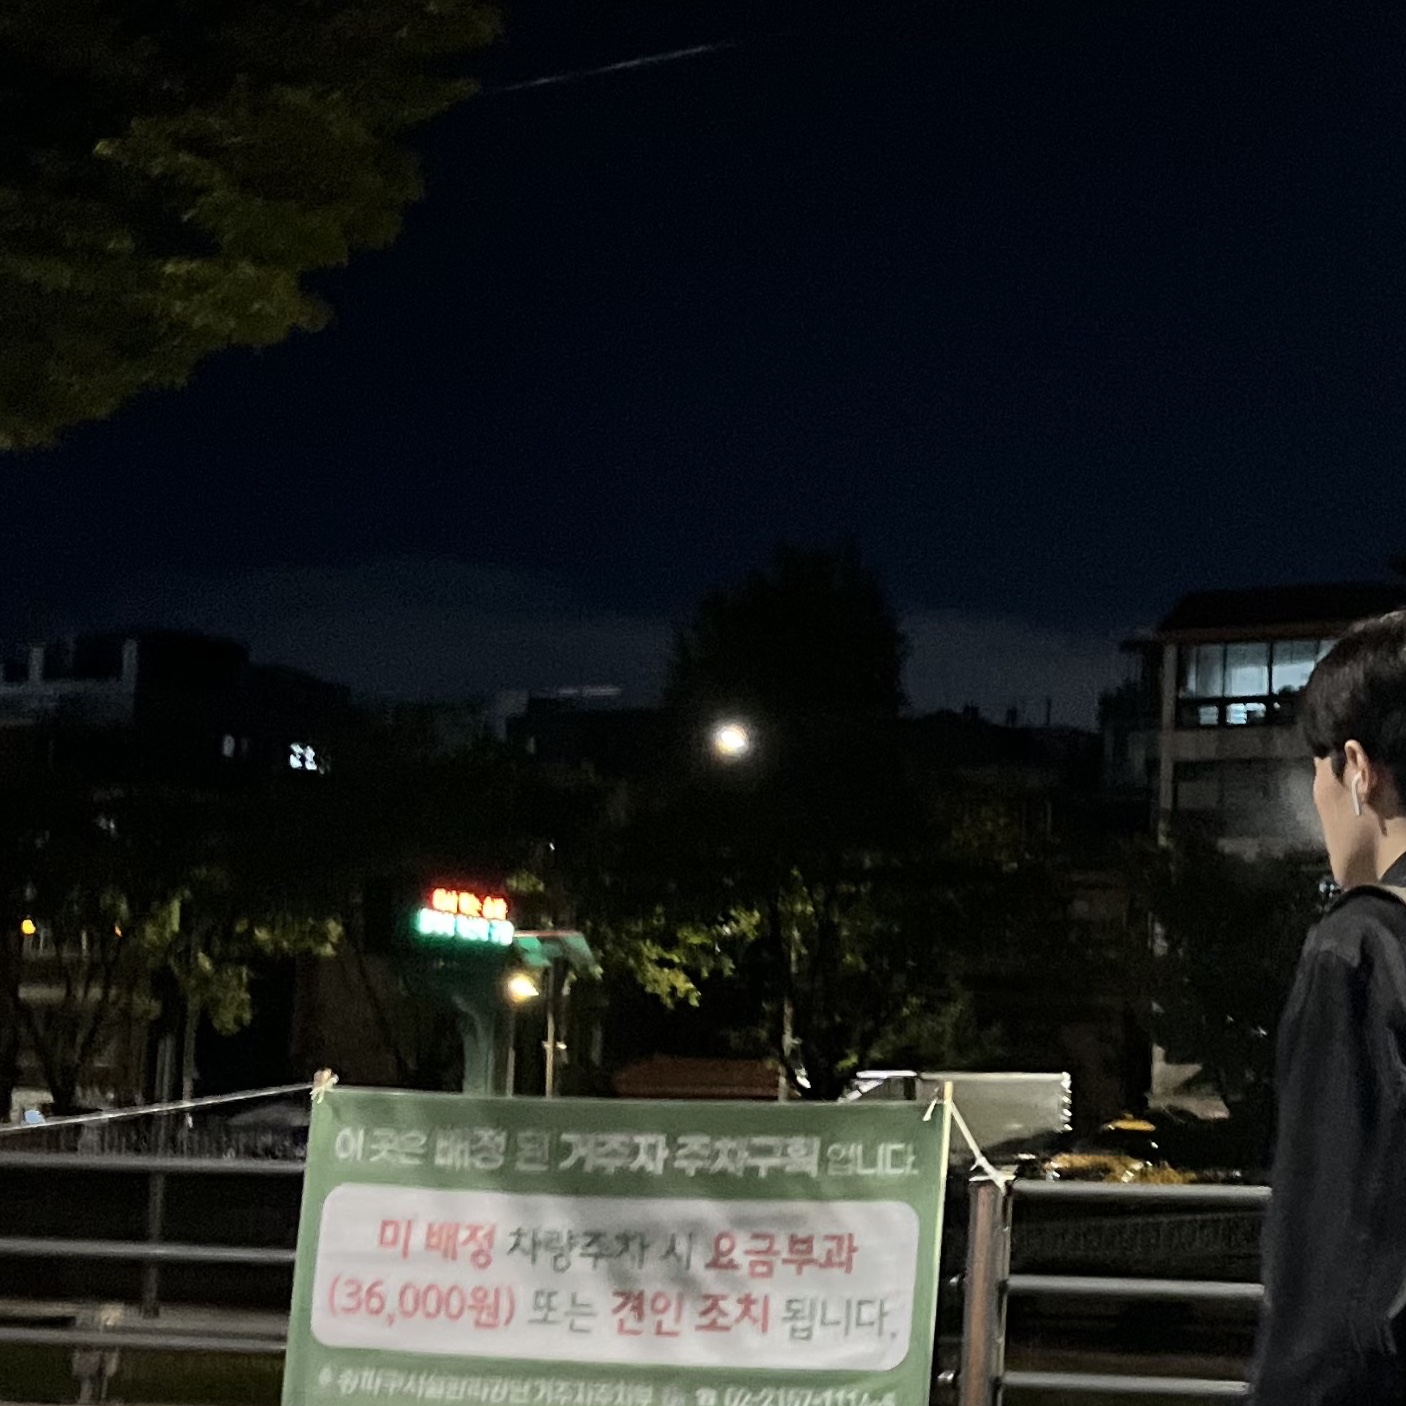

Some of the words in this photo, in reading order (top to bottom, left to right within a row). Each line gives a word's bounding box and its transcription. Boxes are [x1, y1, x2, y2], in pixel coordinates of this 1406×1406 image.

[434, 1126, 507, 1170] 배정
[559, 1131, 668, 1175] 거주자
[377, 1219, 412, 1260] 미
[424, 1222, 497, 1270] 배정
[662, 1230, 695, 1270] 시
[704, 1231, 858, 1279] 요금부과
[328, 1274, 516, 1329] (36,000원)
[527, 1288, 599, 1334] 또는
[611, 1290, 683, 1337] 견인
[694, 1292, 769, 1334] 조치
[780, 1297, 898, 1341] 됩니다.
